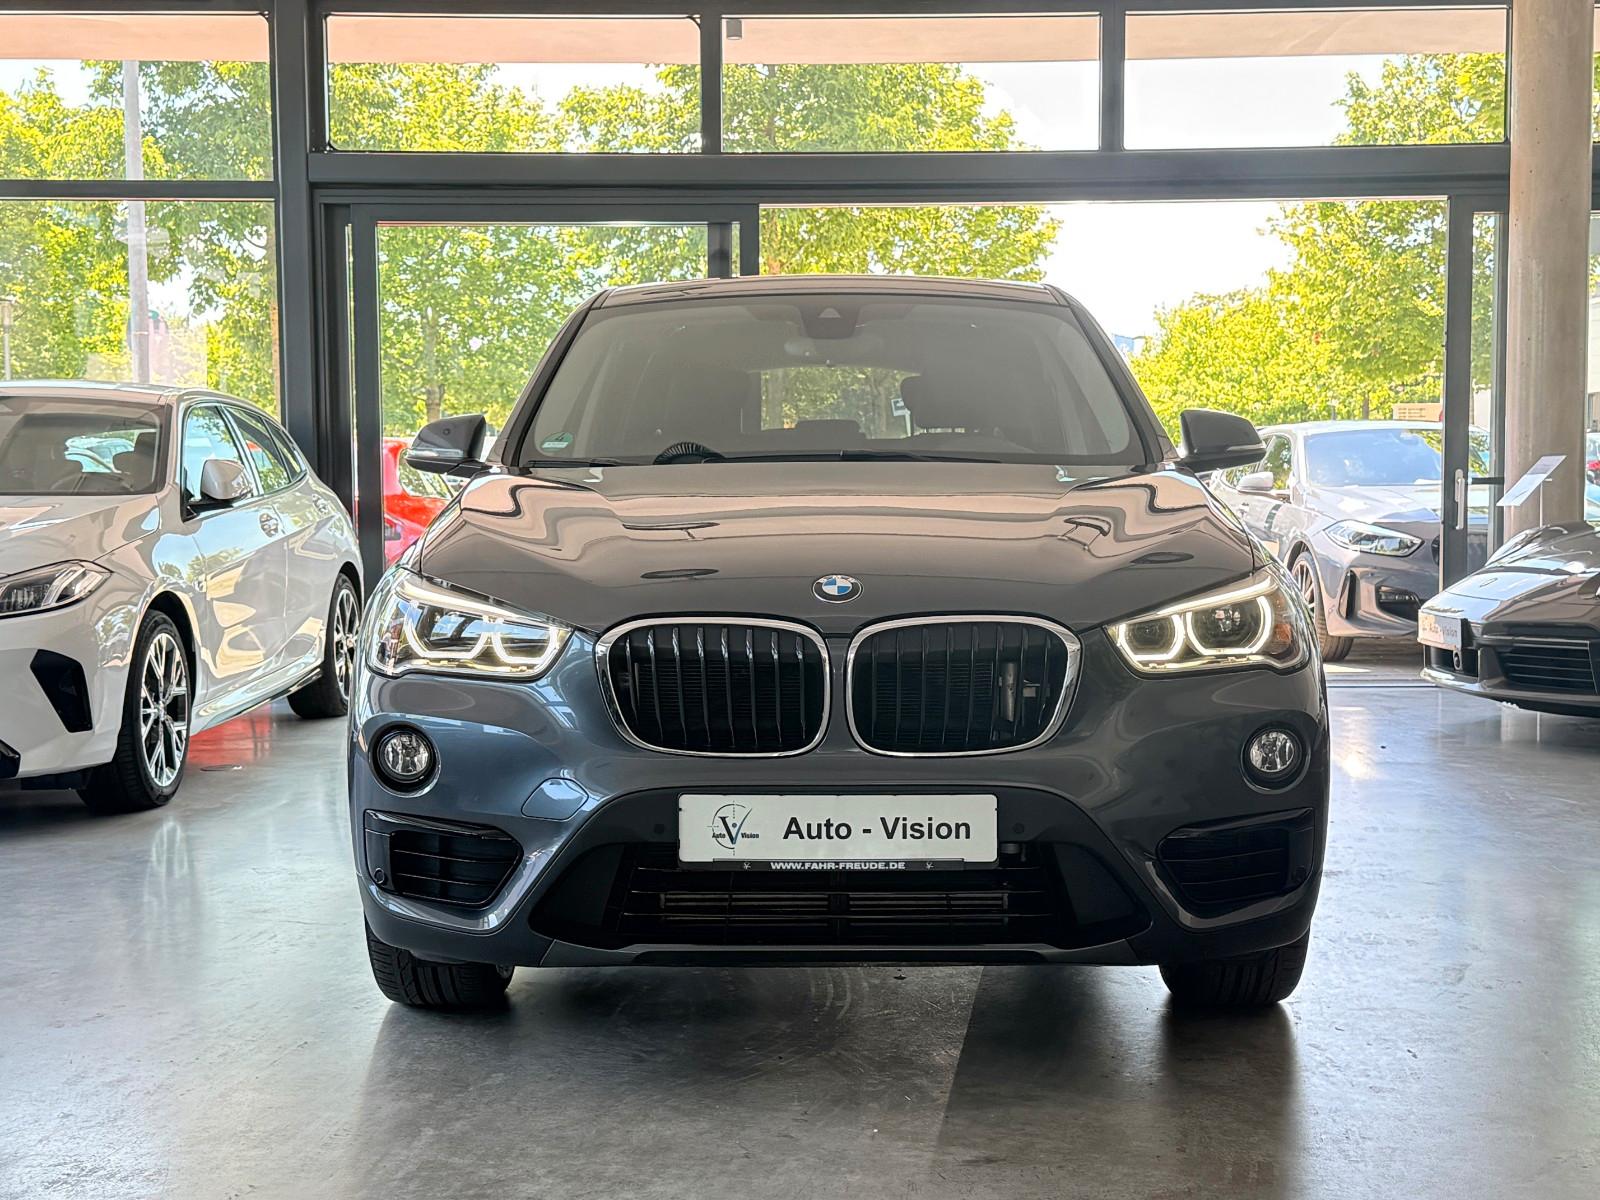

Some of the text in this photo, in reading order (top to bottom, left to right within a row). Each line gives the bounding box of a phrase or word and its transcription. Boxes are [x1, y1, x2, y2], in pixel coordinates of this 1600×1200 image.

[782, 816, 852, 840] Auto
[880, 816, 971, 840] Vision
[770, 862, 906, 870] WWW.FAHR-FREUDE.DE
